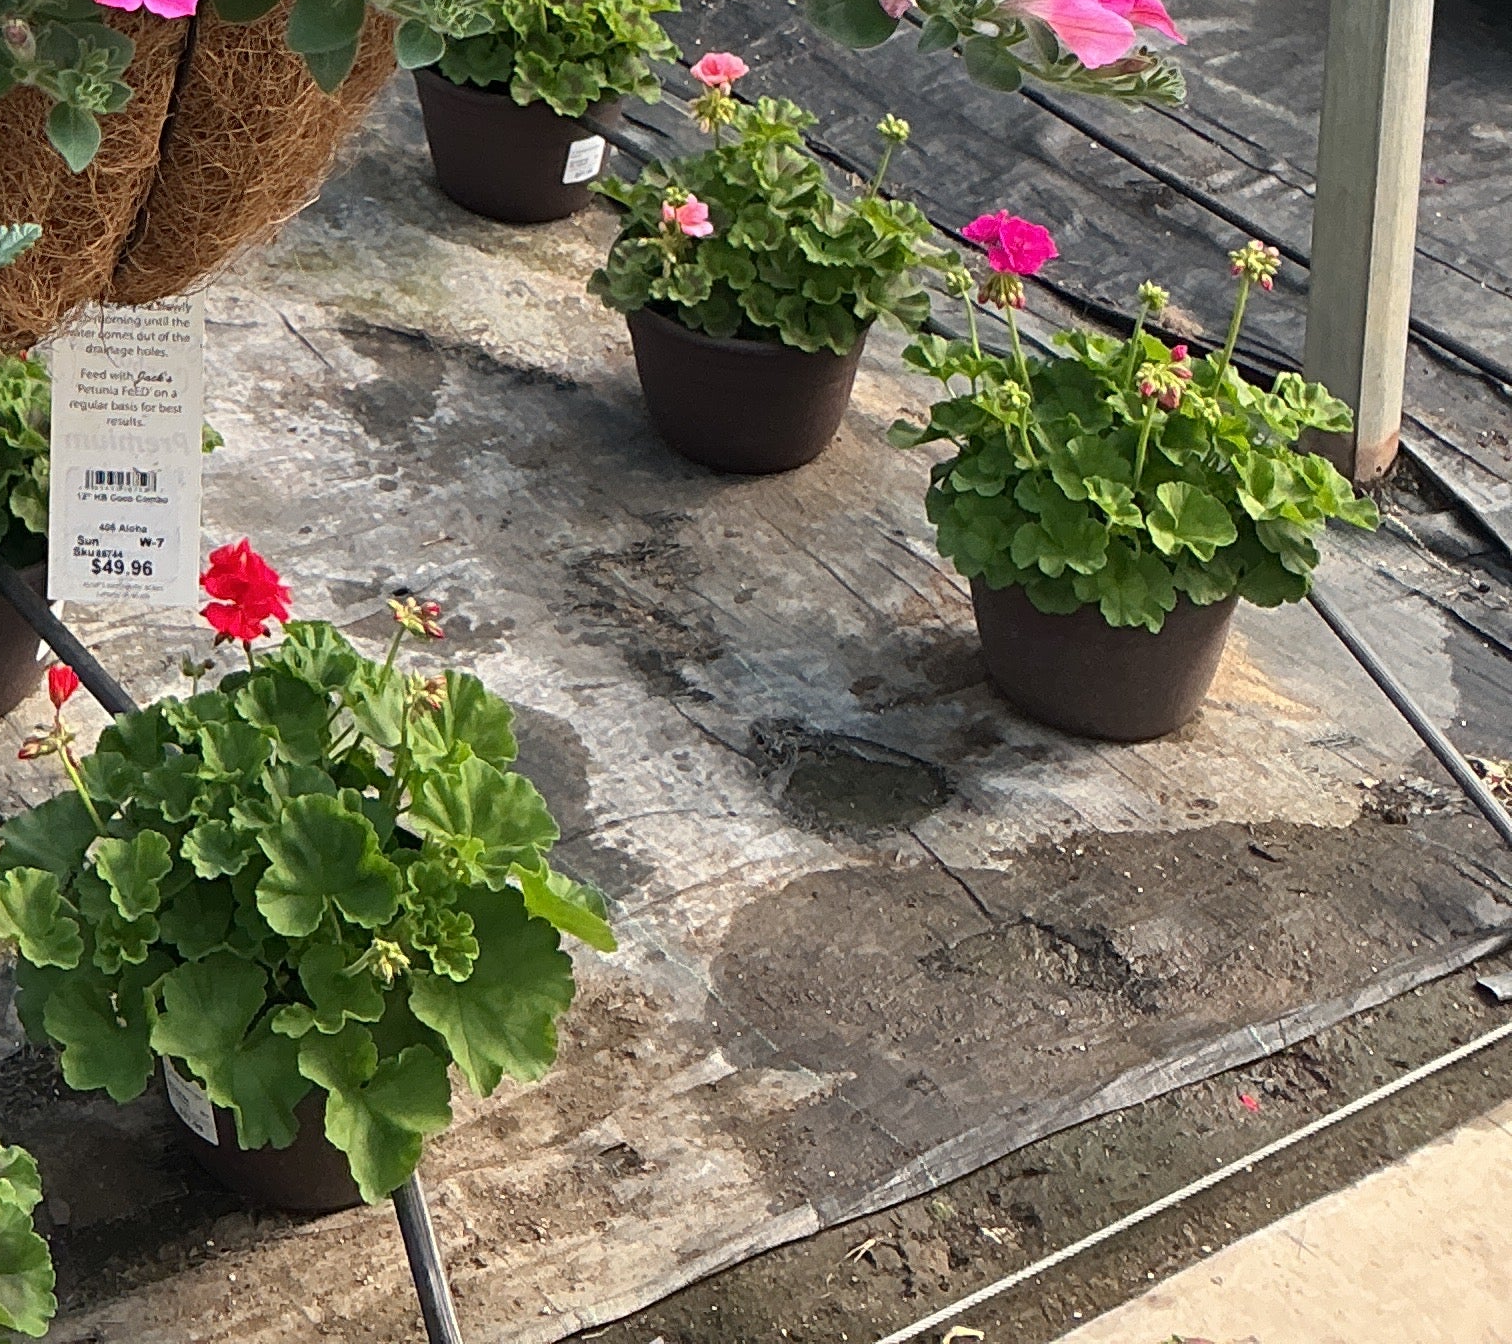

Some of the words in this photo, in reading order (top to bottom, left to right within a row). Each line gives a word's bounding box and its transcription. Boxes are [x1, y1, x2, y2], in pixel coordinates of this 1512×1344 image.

[144, 317, 169, 327] until
[172, 317, 191, 328] the
[137, 332, 157, 342] out
[158, 331, 170, 342] of
[172, 332, 191, 343] the
[80, 368, 107, 380] Feed
[110, 369, 134, 380] with
[154, 389, 169, 398] on
[171, 389, 178, 398] a
[69, 400, 109, 412] regular
[111, 400, 138, 412] basis
[141, 402, 156, 412] for
[158, 403, 183, 414] best
[119, 524, 148, 533] Aloha
[76, 535, 100, 547] Sun
[139, 537, 165, 548] W-7
[91, 558, 153, 577] $49.96
